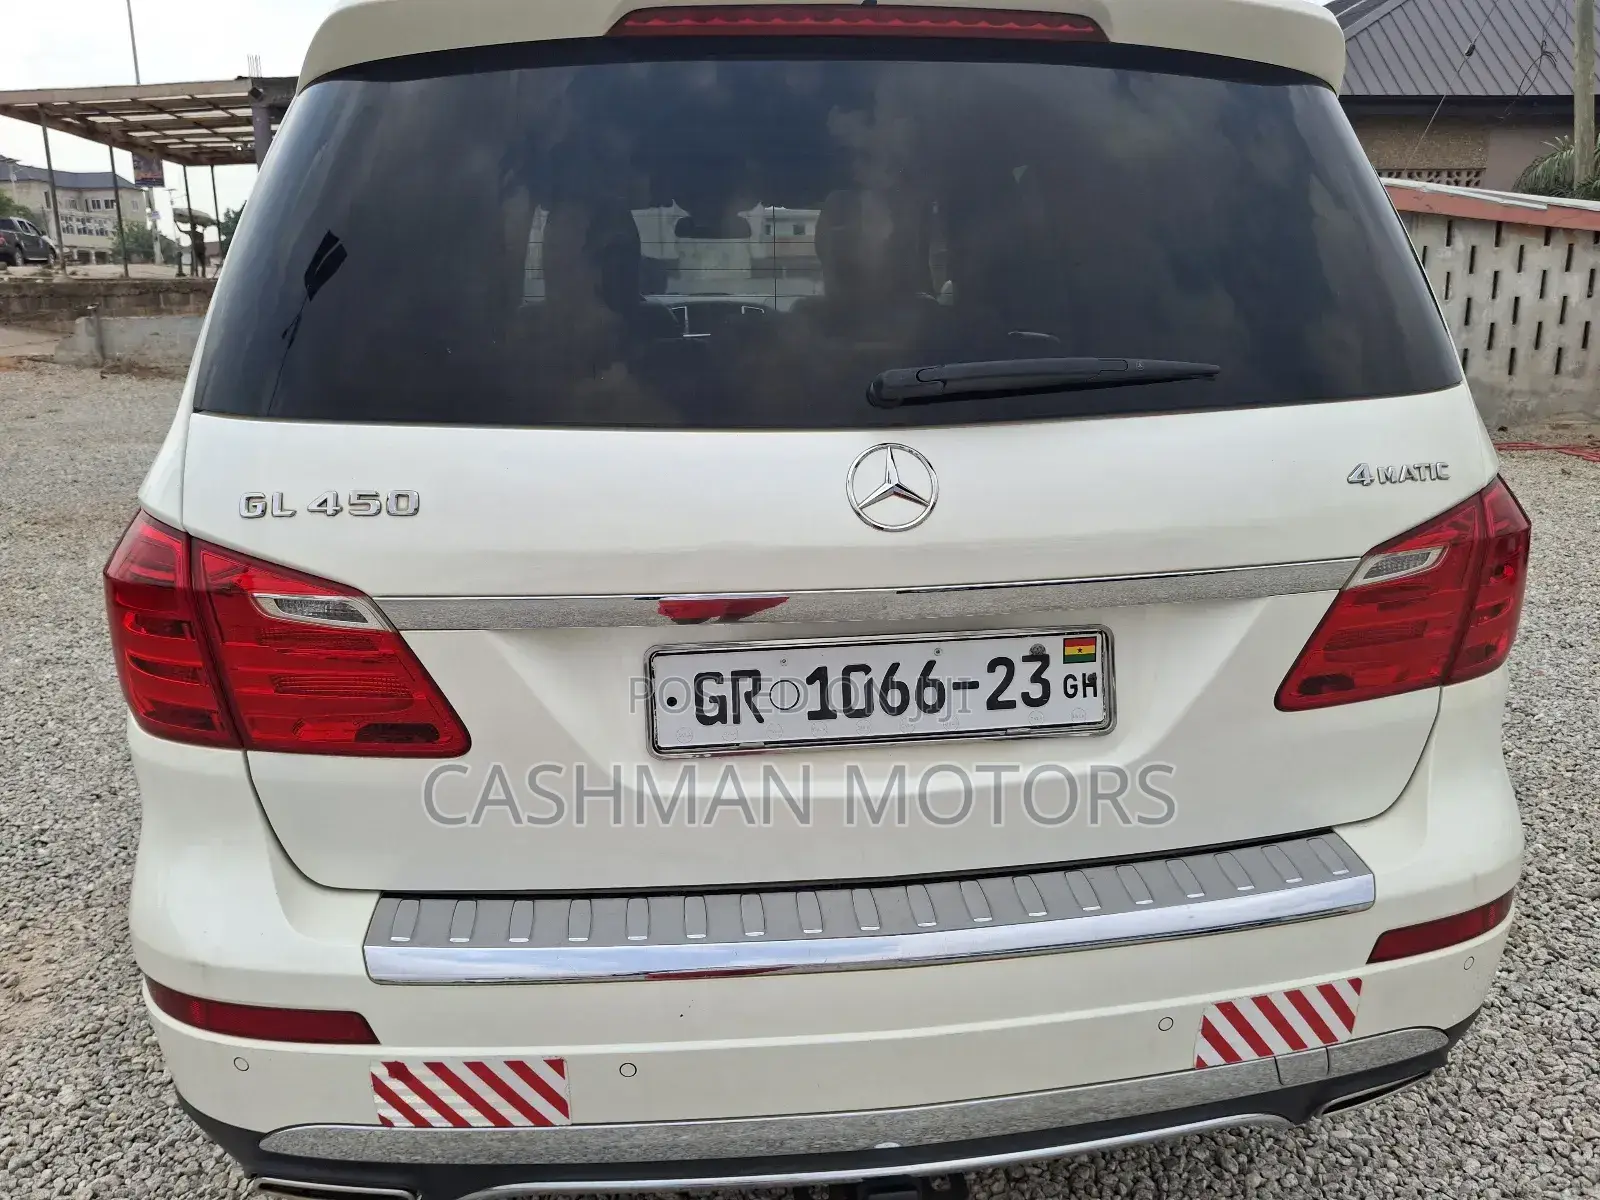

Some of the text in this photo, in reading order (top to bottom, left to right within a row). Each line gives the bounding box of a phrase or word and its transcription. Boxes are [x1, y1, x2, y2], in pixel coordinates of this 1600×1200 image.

[239, 489, 420, 518] GL 450
[693, 653, 1051, 726] GR 1066-23
[1062, 672, 1098, 699] GH
